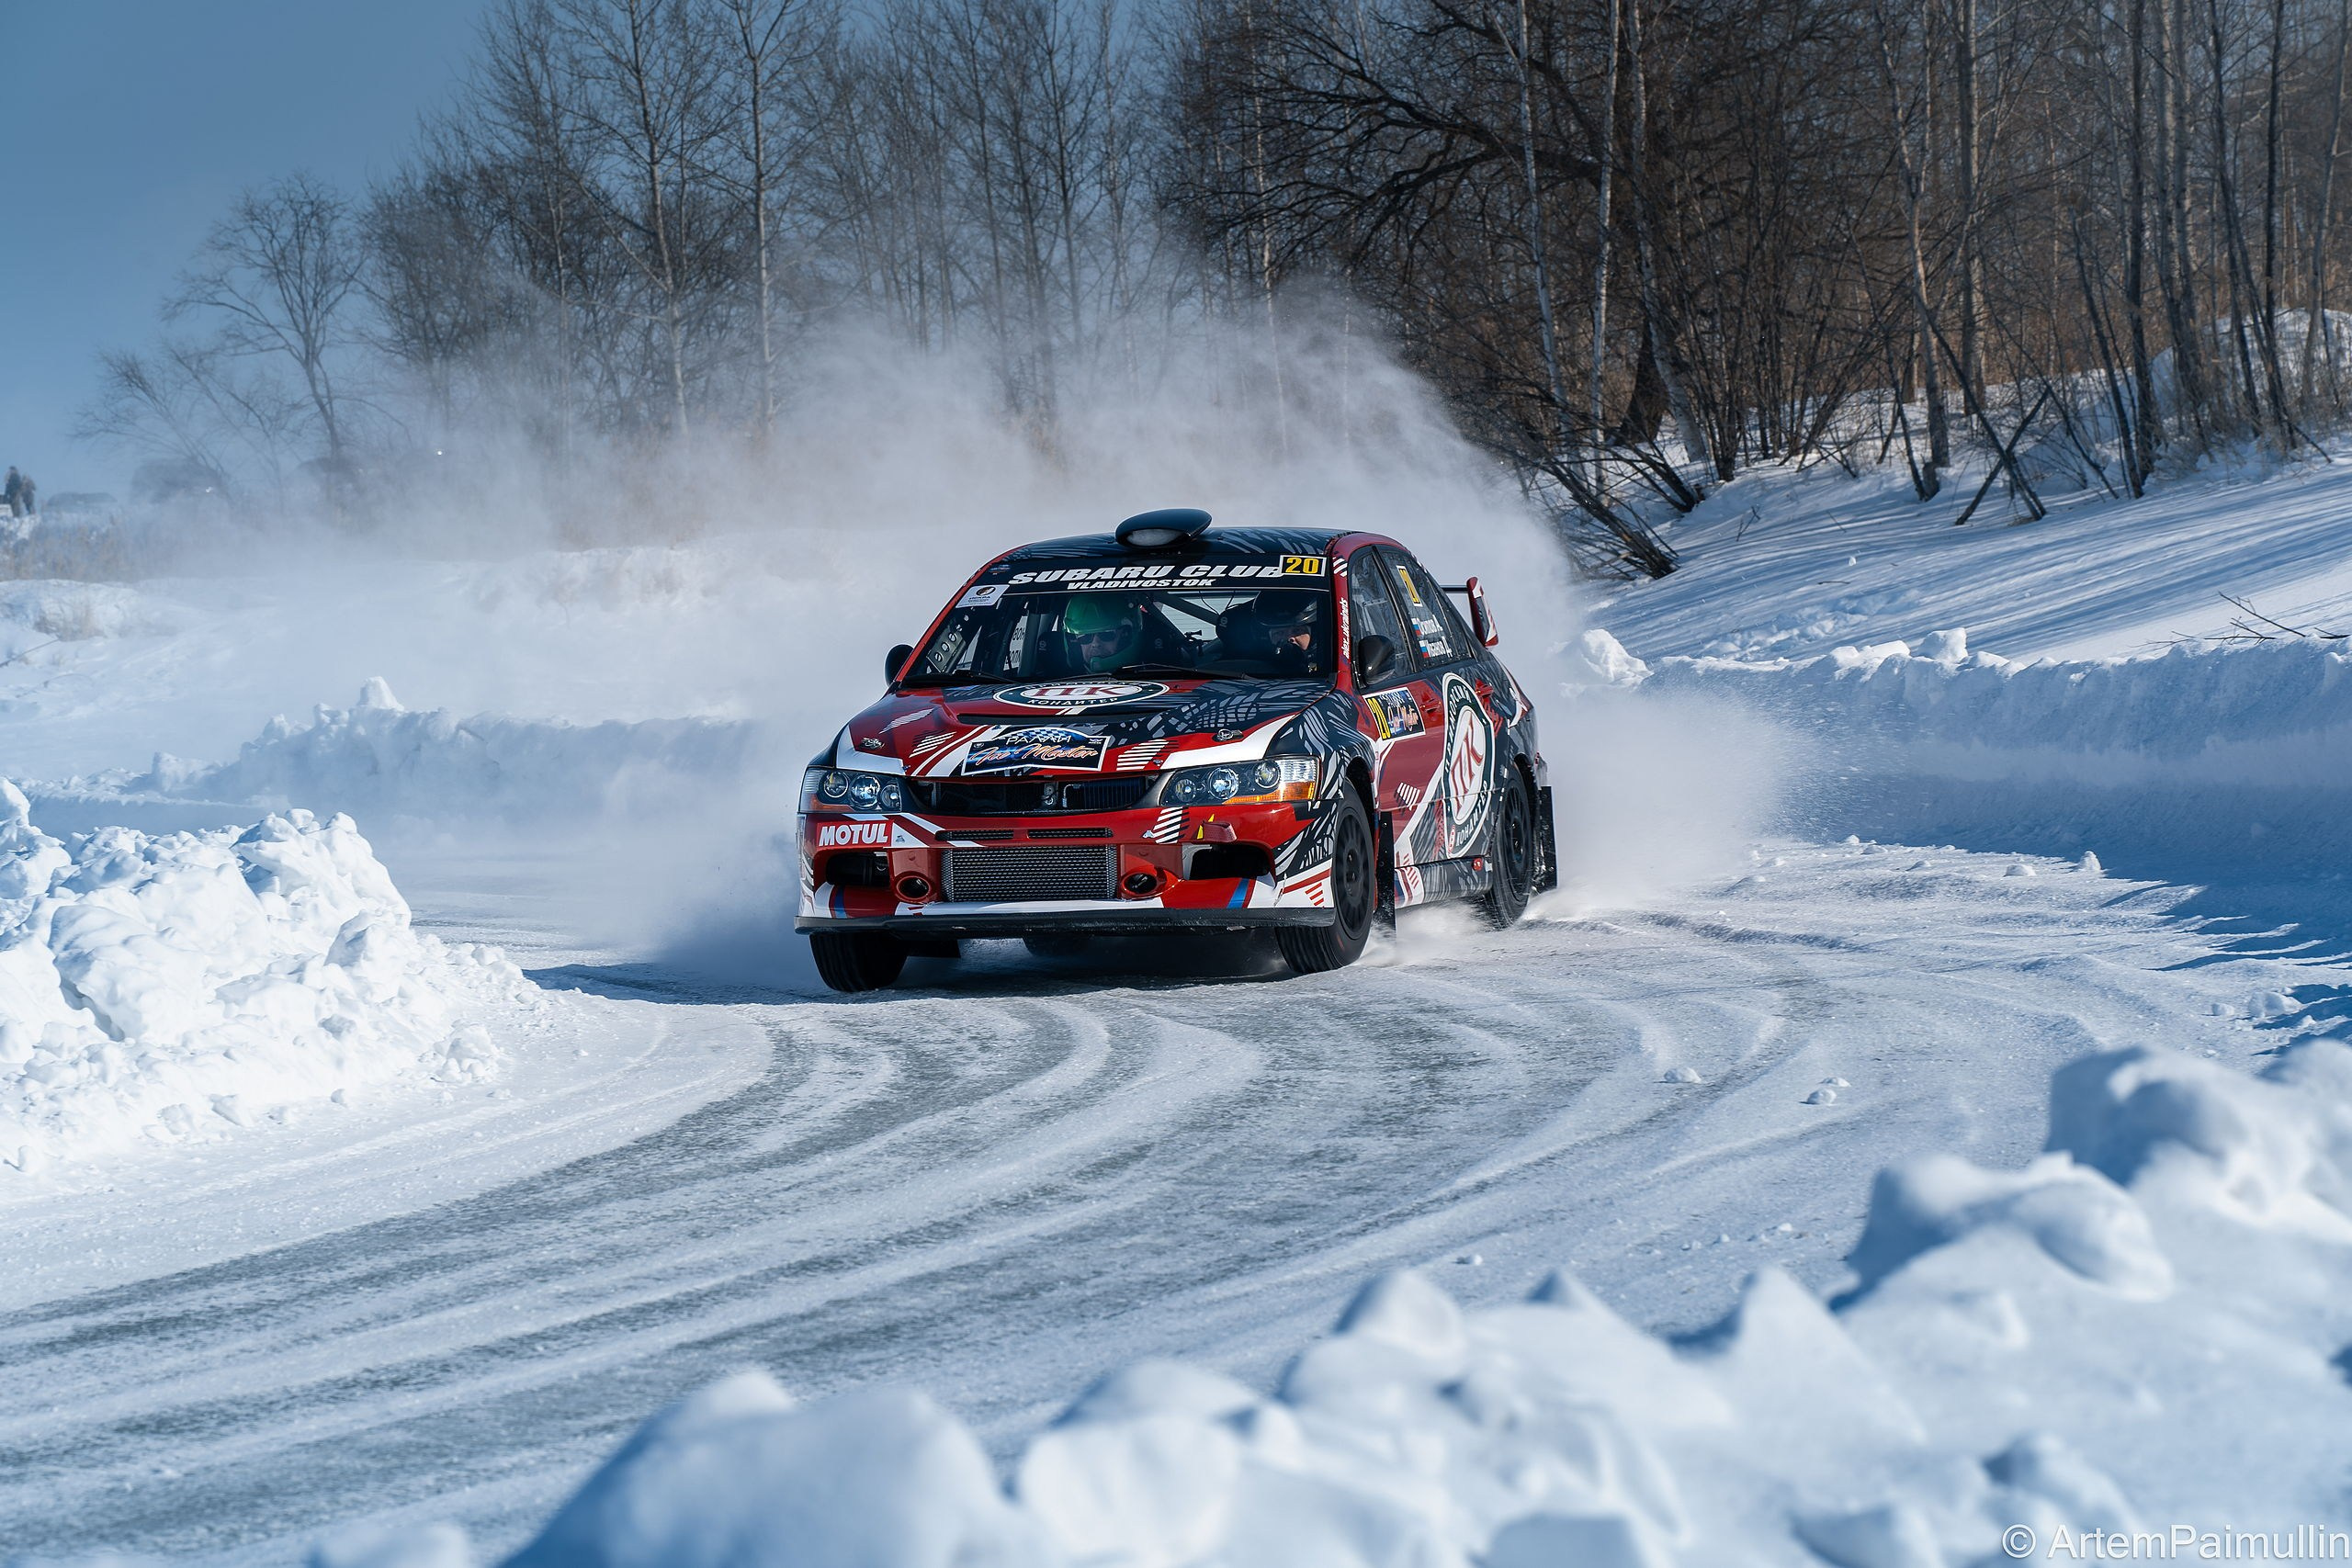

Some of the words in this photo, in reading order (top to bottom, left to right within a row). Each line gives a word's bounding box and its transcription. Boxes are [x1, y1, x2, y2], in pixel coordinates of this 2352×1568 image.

[1008, 565, 1175, 584] SUBARU
[1179, 565, 1283, 578] CLUB
[1285, 557, 1319, 574] 20
[1067, 579, 1216, 590] VLADIVOSTOK
[1027, 697, 1118, 705] КОНДИТЕР
[1367, 697, 1391, 739] 20
[1005, 735, 1072, 745] РАЛЛИ
[1014, 743, 1098, 761] Master
[1451, 713, 1484, 818] ПК
[819, 822, 889, 847] MOTUL
